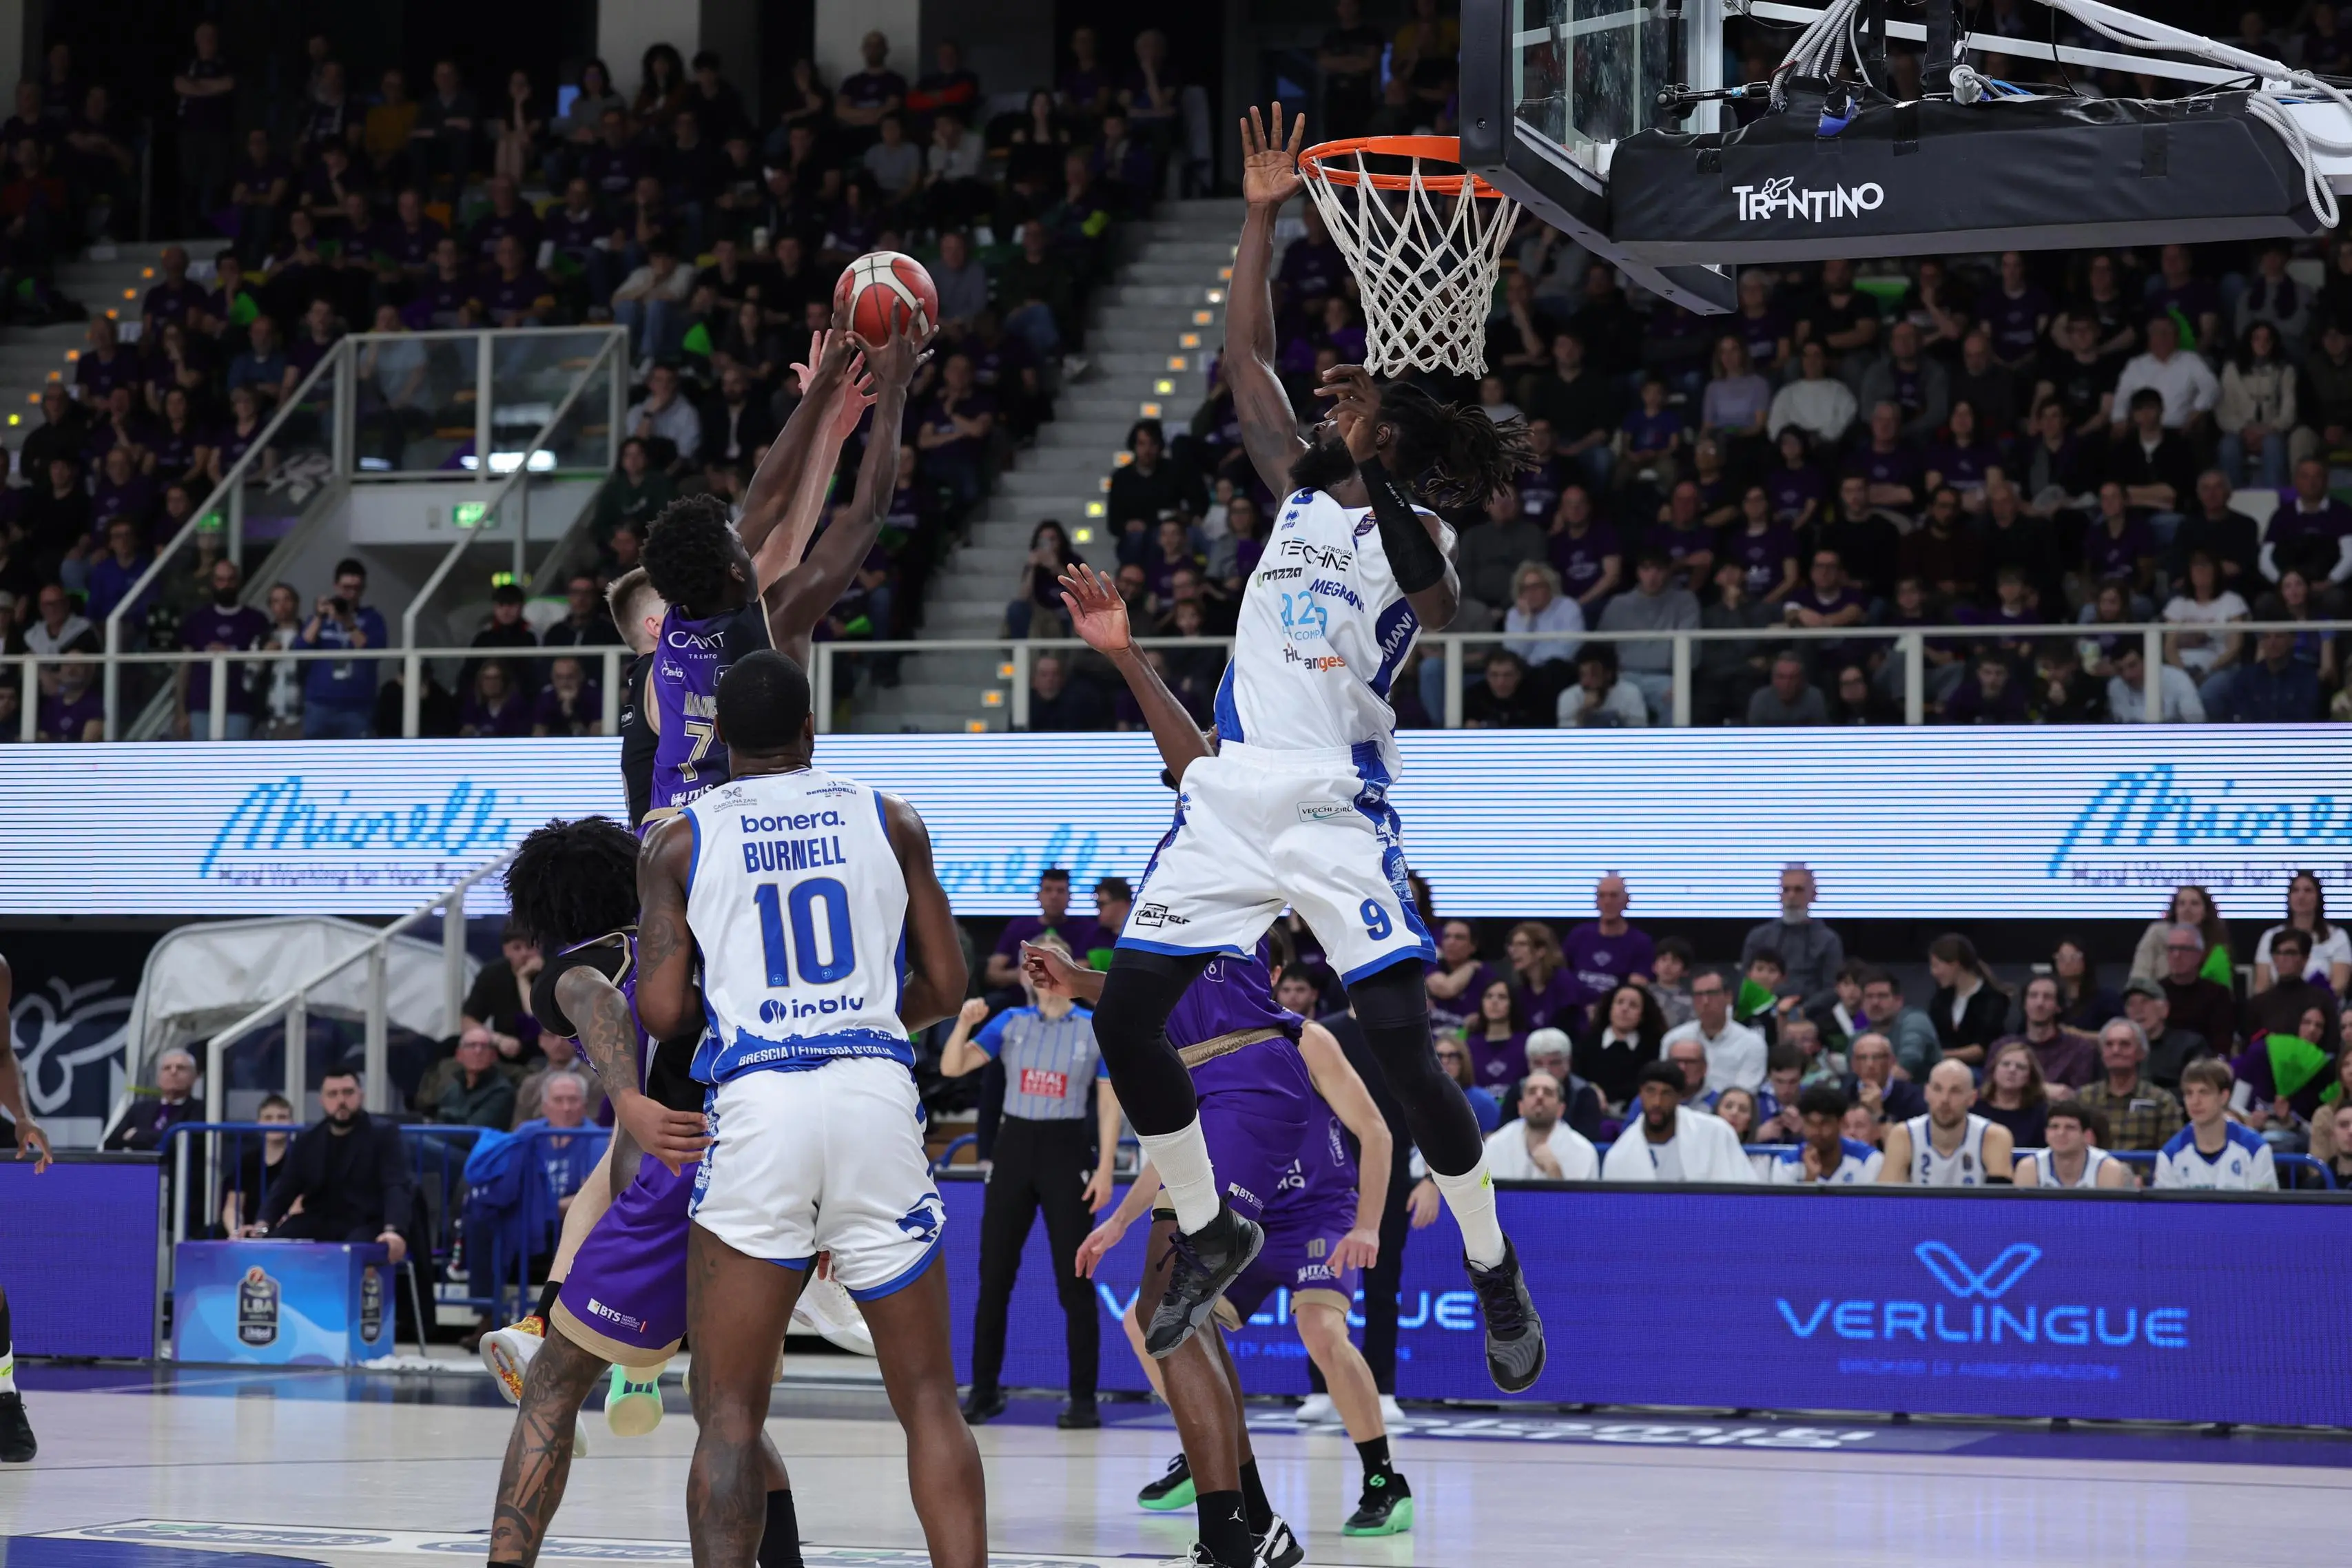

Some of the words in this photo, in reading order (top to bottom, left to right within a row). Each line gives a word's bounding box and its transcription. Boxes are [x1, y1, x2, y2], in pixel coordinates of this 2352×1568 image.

[1732, 176, 1884, 223] TRENTINO
[1321, 545, 1352, 557] ETROLOGIA
[678, 721, 714, 783] 7
[806, 787, 857, 795] BERNARDELLI
[713, 799, 742, 810] CAROLINA
[741, 810, 846, 833] bonera.
[2048, 765, 2352, 878] Miore
[742, 836, 846, 873] BURNELL
[1359, 898, 1392, 941] 9
[753, 876, 856, 989] 10
[792, 996, 864, 1018] inblu
[738, 1046, 789, 1066] BRESCIA
[1239, 1187, 1255, 1203] BTS
[1306, 1238, 1326, 1259] 10
[599, 1305, 621, 1322] BTS
[1775, 1298, 2191, 1348] VERLINGUE
